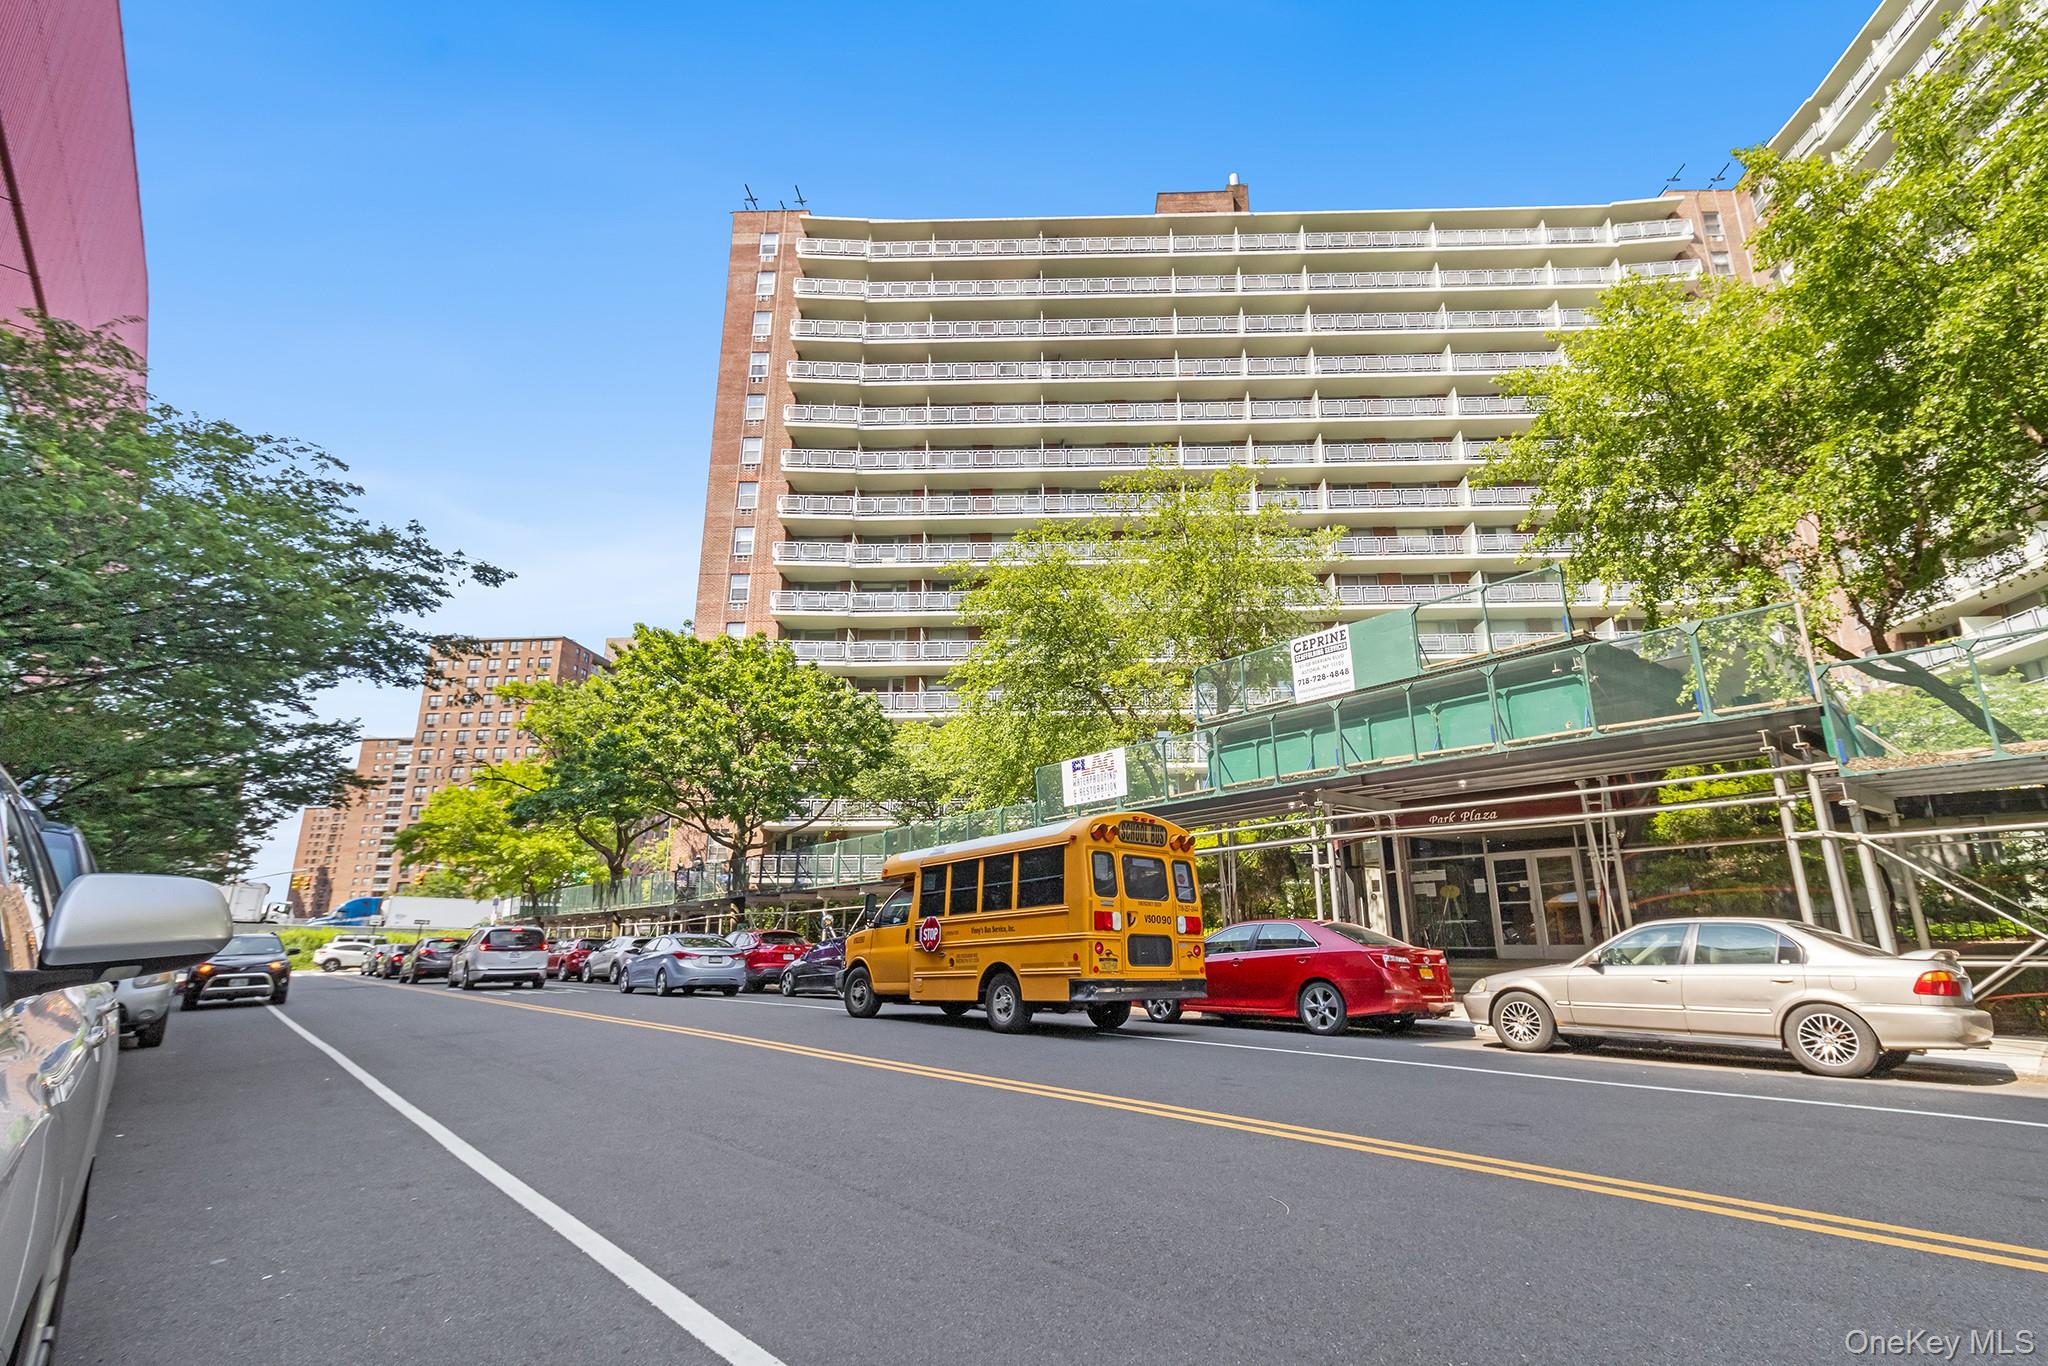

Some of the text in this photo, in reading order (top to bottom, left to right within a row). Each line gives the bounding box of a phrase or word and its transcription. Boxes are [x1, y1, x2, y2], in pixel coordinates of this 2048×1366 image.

[1293, 629, 1347, 653] CEPRINE
[1298, 667, 1350, 686] 718-728-4848
[1080, 782, 1117, 797] RESTORATION
[1429, 809, 1498, 824] Park Plaza
[1121, 822, 1164, 845] SCHOOL BUS
[923, 927, 939, 941] STOP
